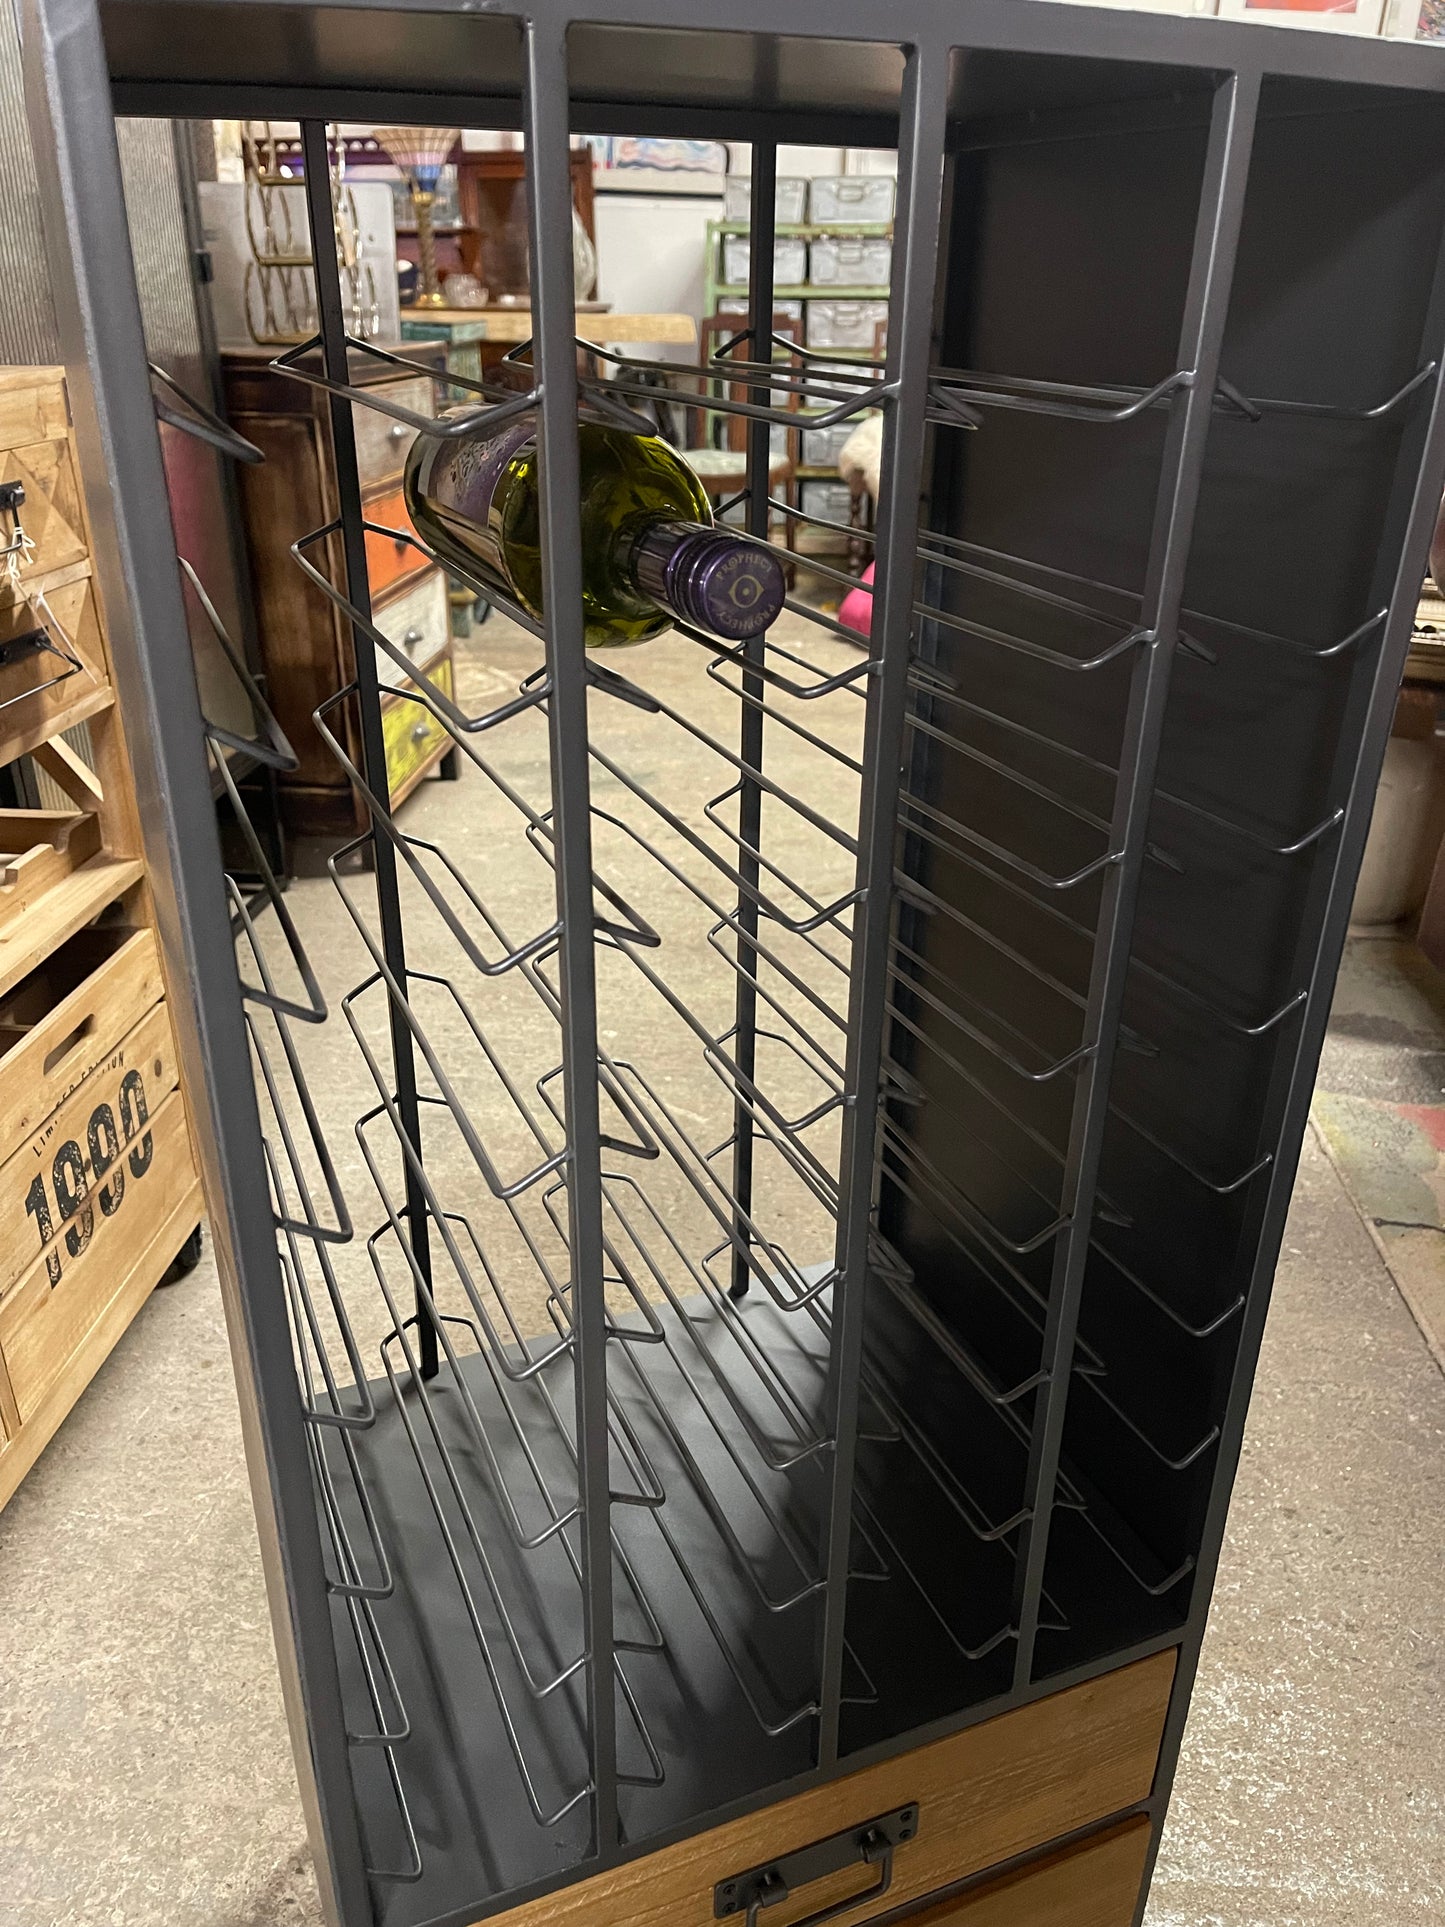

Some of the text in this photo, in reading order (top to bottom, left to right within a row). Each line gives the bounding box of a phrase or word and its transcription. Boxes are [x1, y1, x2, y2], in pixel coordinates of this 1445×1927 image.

[716, 552, 772, 580] PROPHECY
[717, 604, 776, 630] PROPHECY
[81, 1050, 124, 1081] EDION
[24, 1069, 154, 1289] 1990
